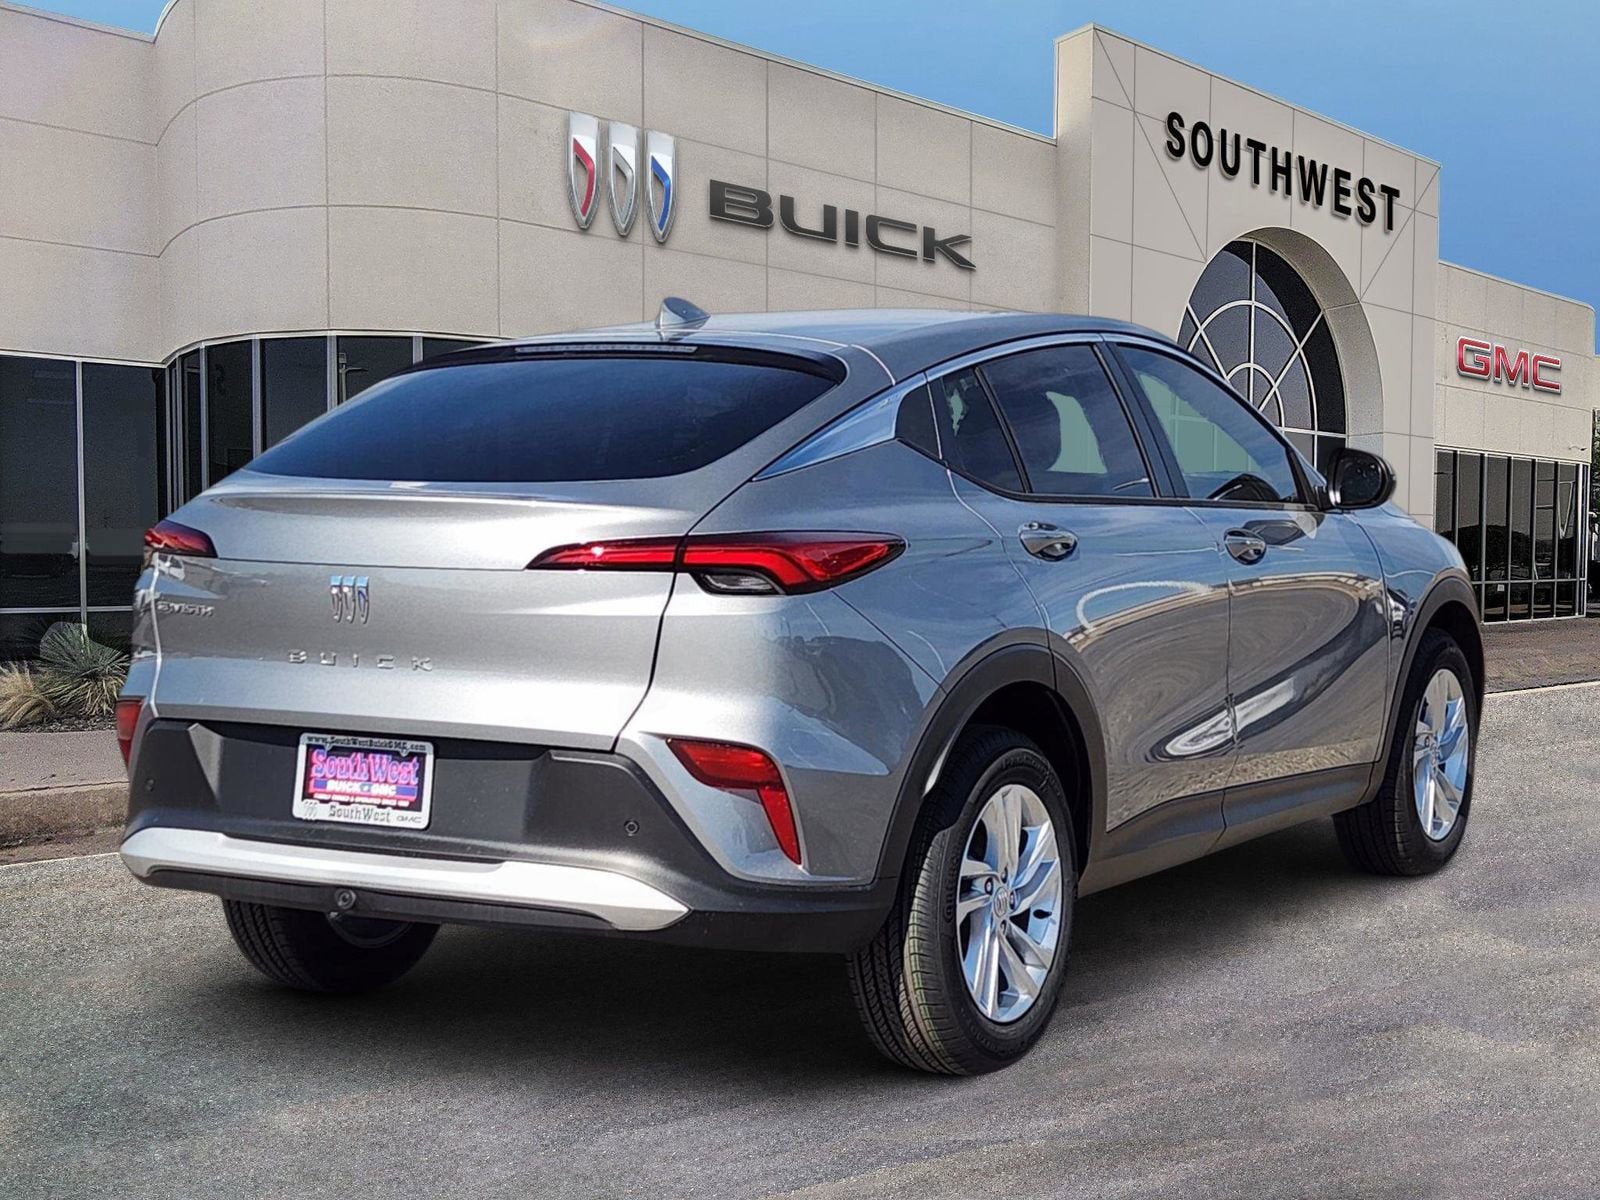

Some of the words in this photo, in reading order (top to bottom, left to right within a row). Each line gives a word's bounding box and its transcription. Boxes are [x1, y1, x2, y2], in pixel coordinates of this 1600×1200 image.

[1166, 111, 1400, 231] SOUTHWEST
[709, 179, 976, 270] BUICK
[1457, 336, 1561, 394] GMC
[288, 650, 432, 671] BUICK
[311, 748, 420, 786] SouthWest
[328, 804, 391, 824] SouthWest
